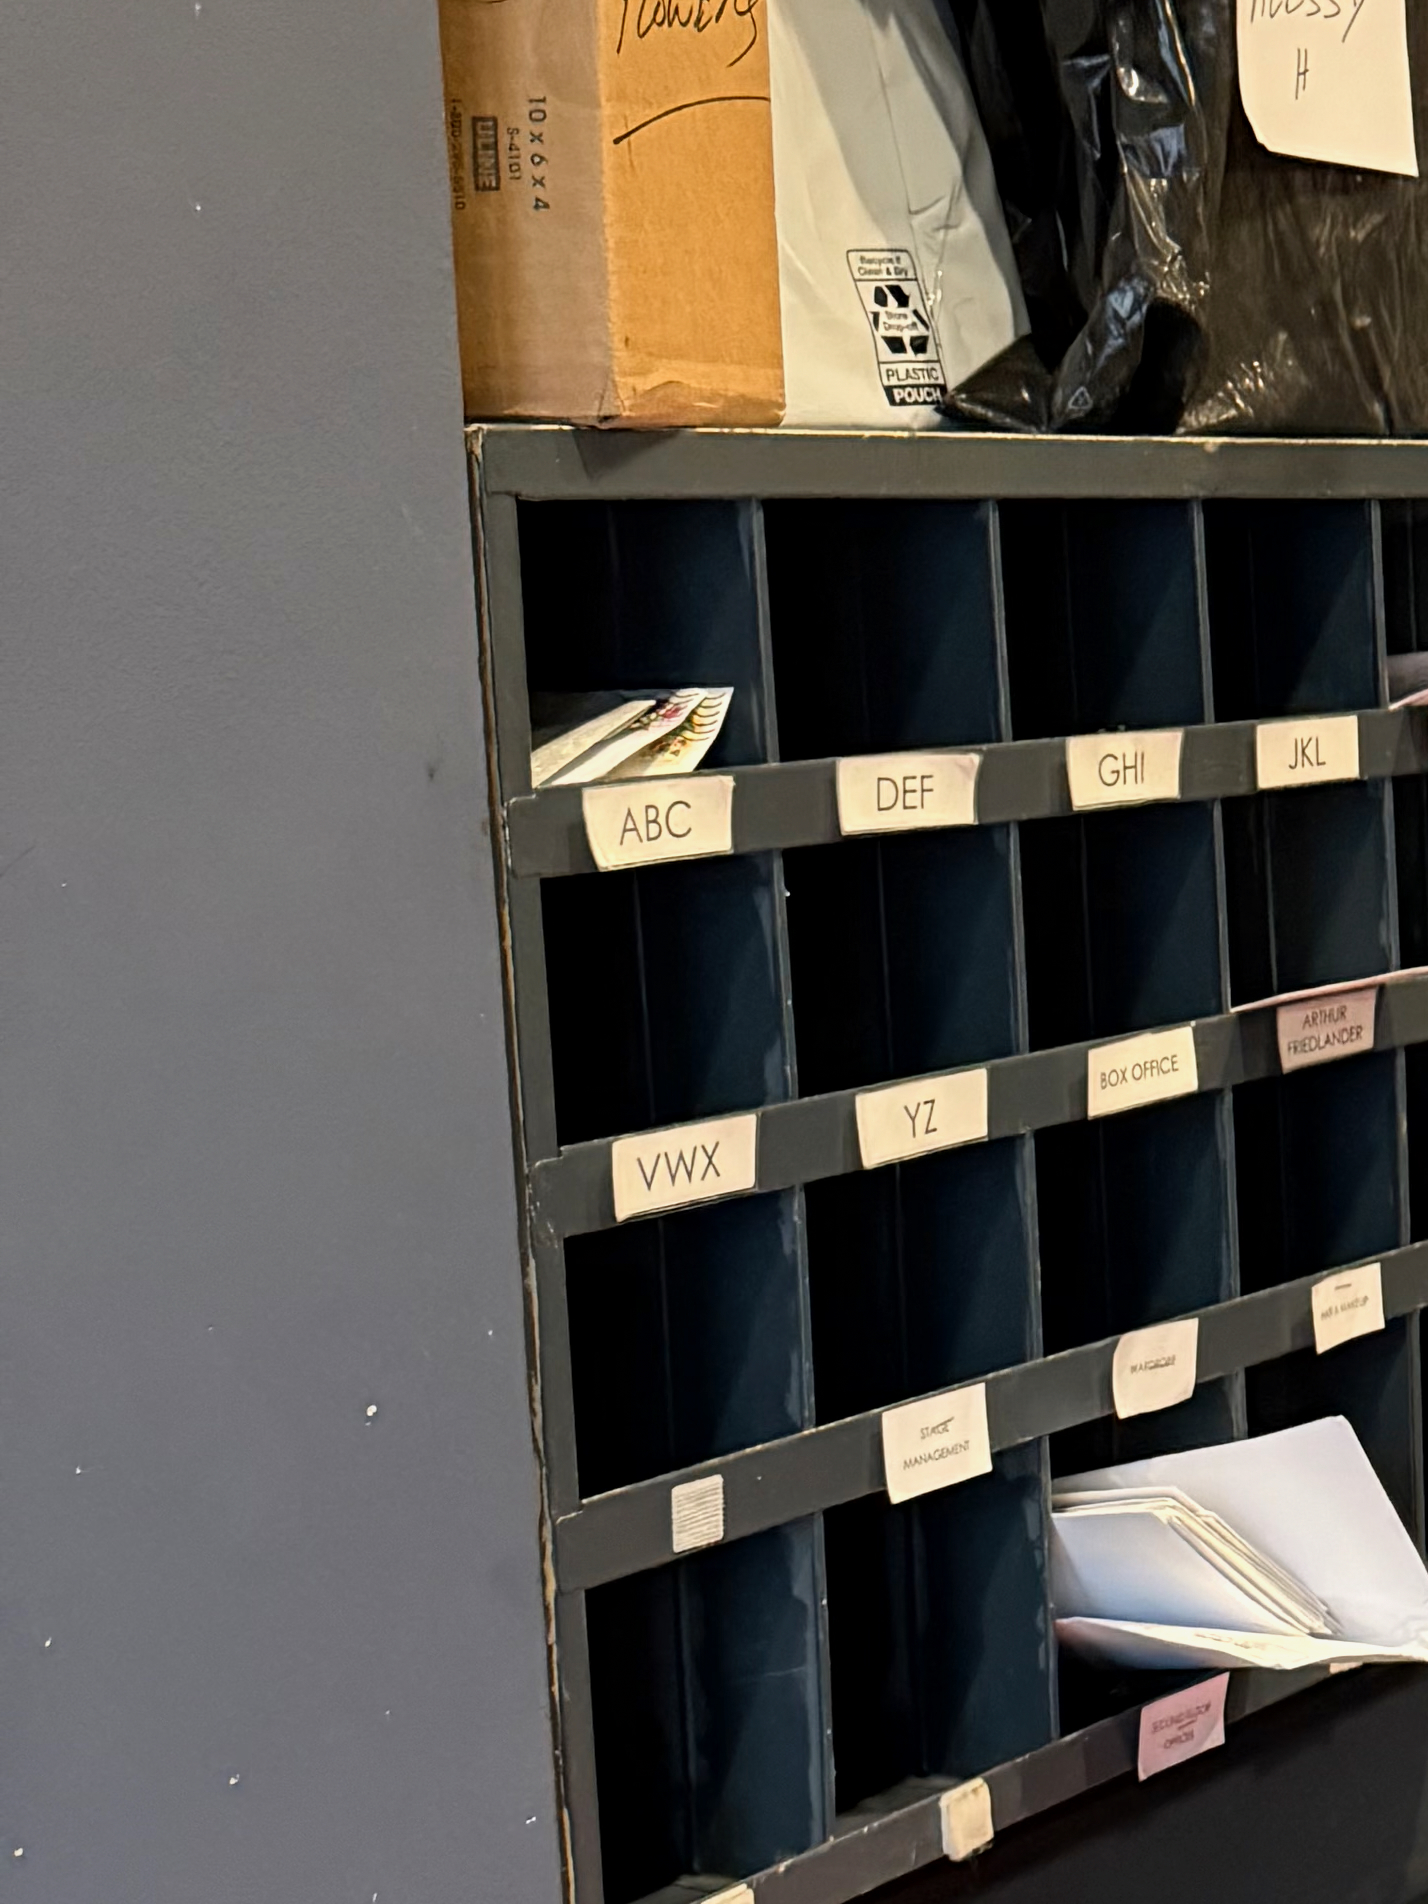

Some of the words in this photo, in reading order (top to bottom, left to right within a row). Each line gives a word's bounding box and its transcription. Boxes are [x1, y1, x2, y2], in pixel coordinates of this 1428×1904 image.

[1294, 48, 1308, 100] H
[527, 96, 548, 123] 10
[530, 153, 548, 167] 6
[533, 195, 550, 211] 4
[886, 367, 939, 382] PLASTIC
[892, 387, 943, 403] POUCH
[1098, 751, 1146, 787] GHI
[1287, 736, 1327, 770] JKL
[875, 773, 936, 812] DEF
[618, 800, 693, 847] ABC
[1302, 1005, 1347, 1030] ARTHUR
[1287, 1027, 1363, 1056] FRIEDLANDER
[1100, 1065, 1128, 1090] BOX
[1131, 1054, 1179, 1082] OFFICE
[904, 1099, 939, 1140] YZ
[636, 1141, 721, 1192] VWX
[903, 1440, 970, 1470] MANAGEMENT
